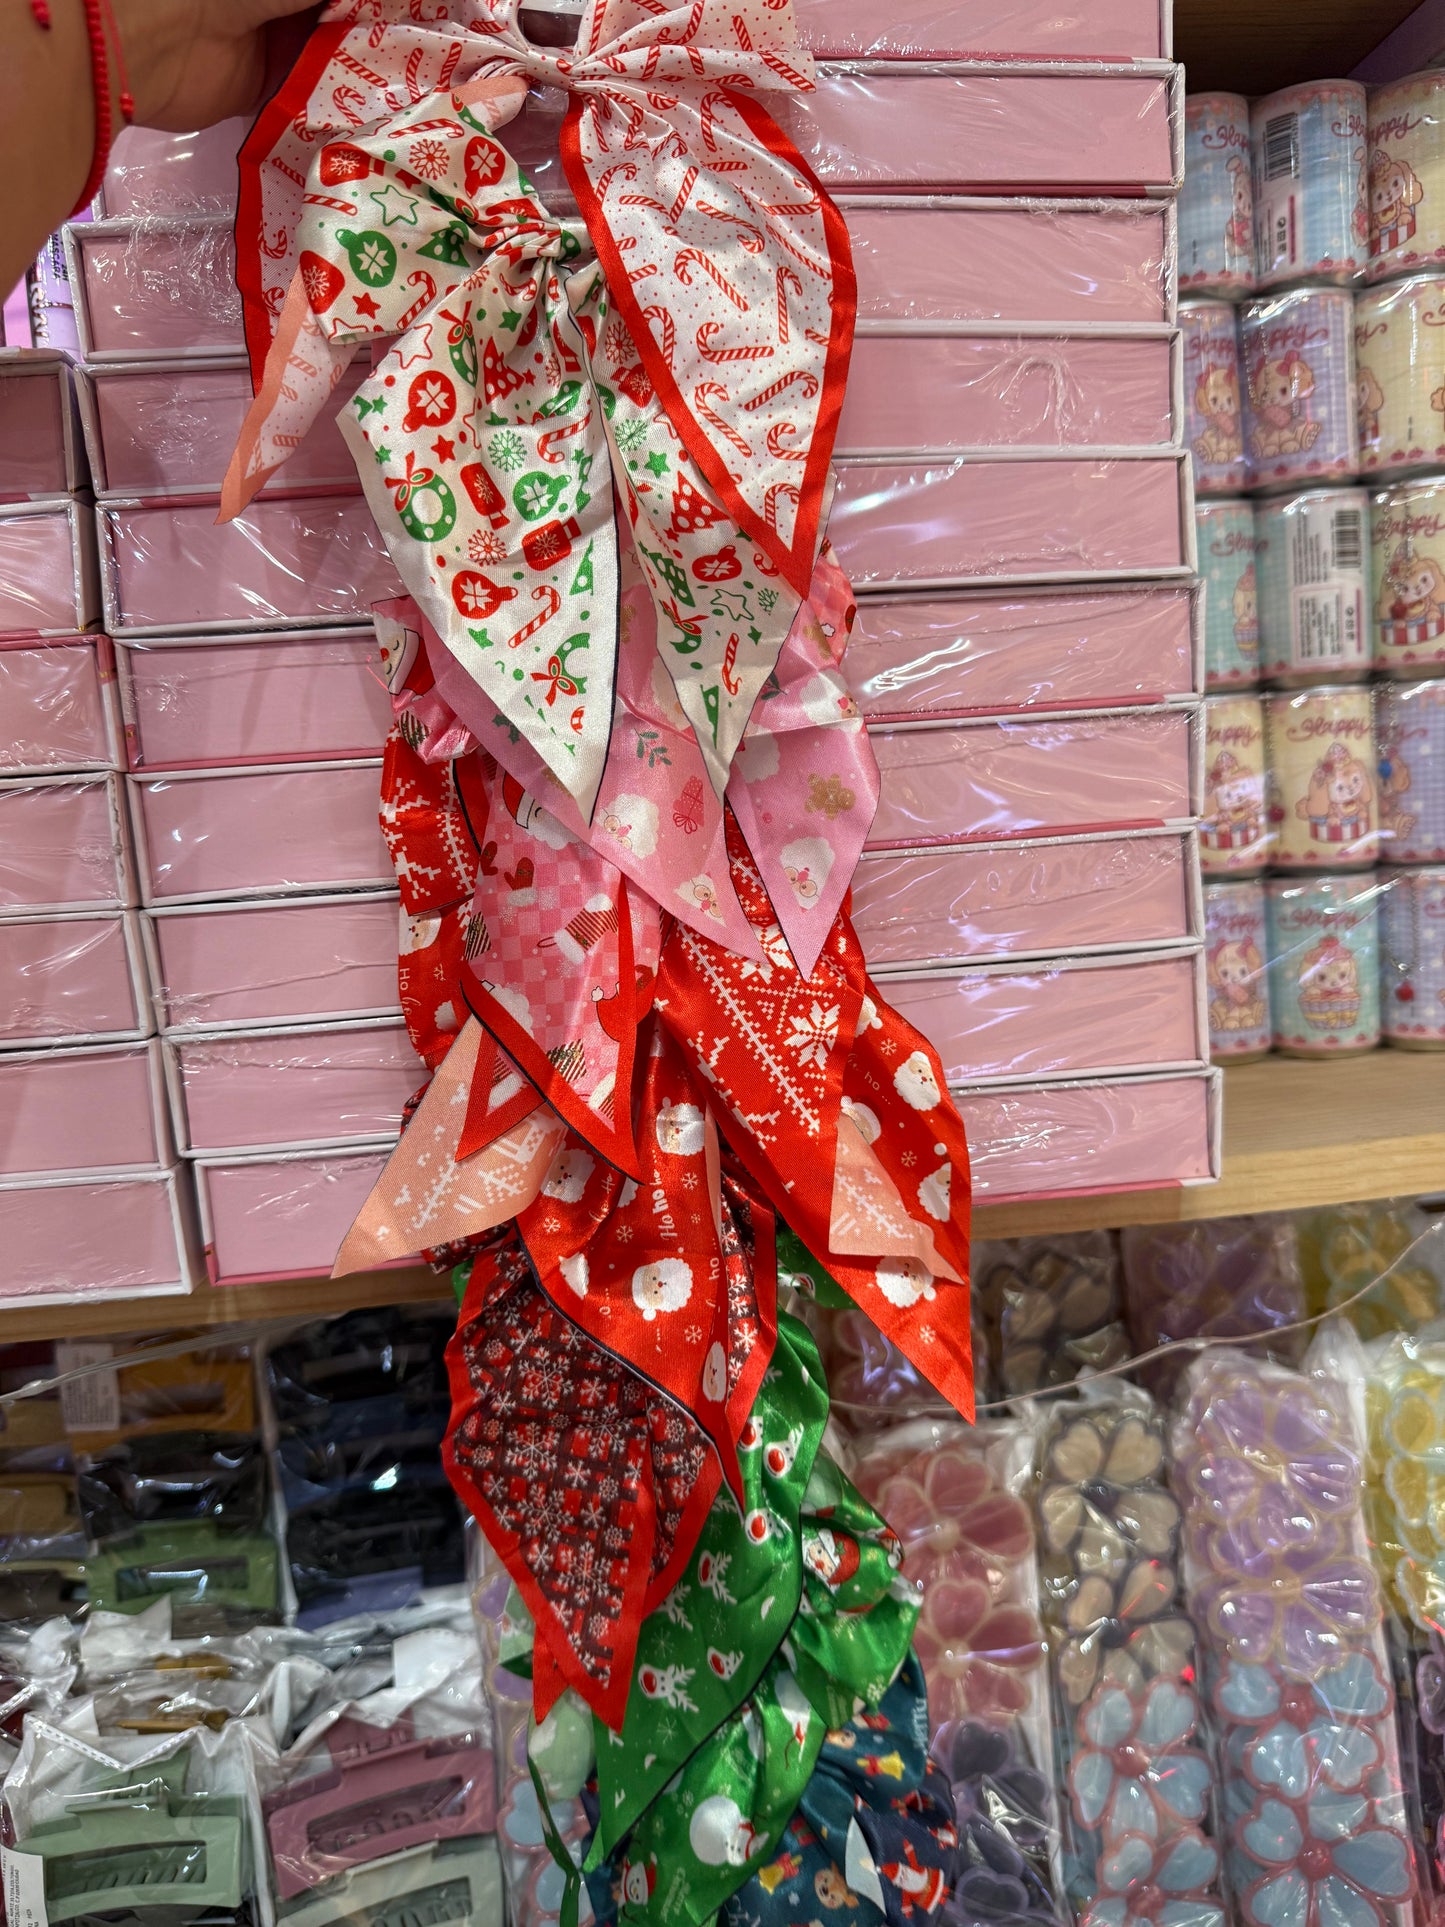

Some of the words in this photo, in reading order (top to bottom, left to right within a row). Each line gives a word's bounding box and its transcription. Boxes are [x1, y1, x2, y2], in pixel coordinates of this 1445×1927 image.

[399, 968, 411, 991] Ho
[652, 1188, 670, 1214] ho
[658, 1213, 679, 1240] Ho
[708, 1257, 720, 1281] ho
